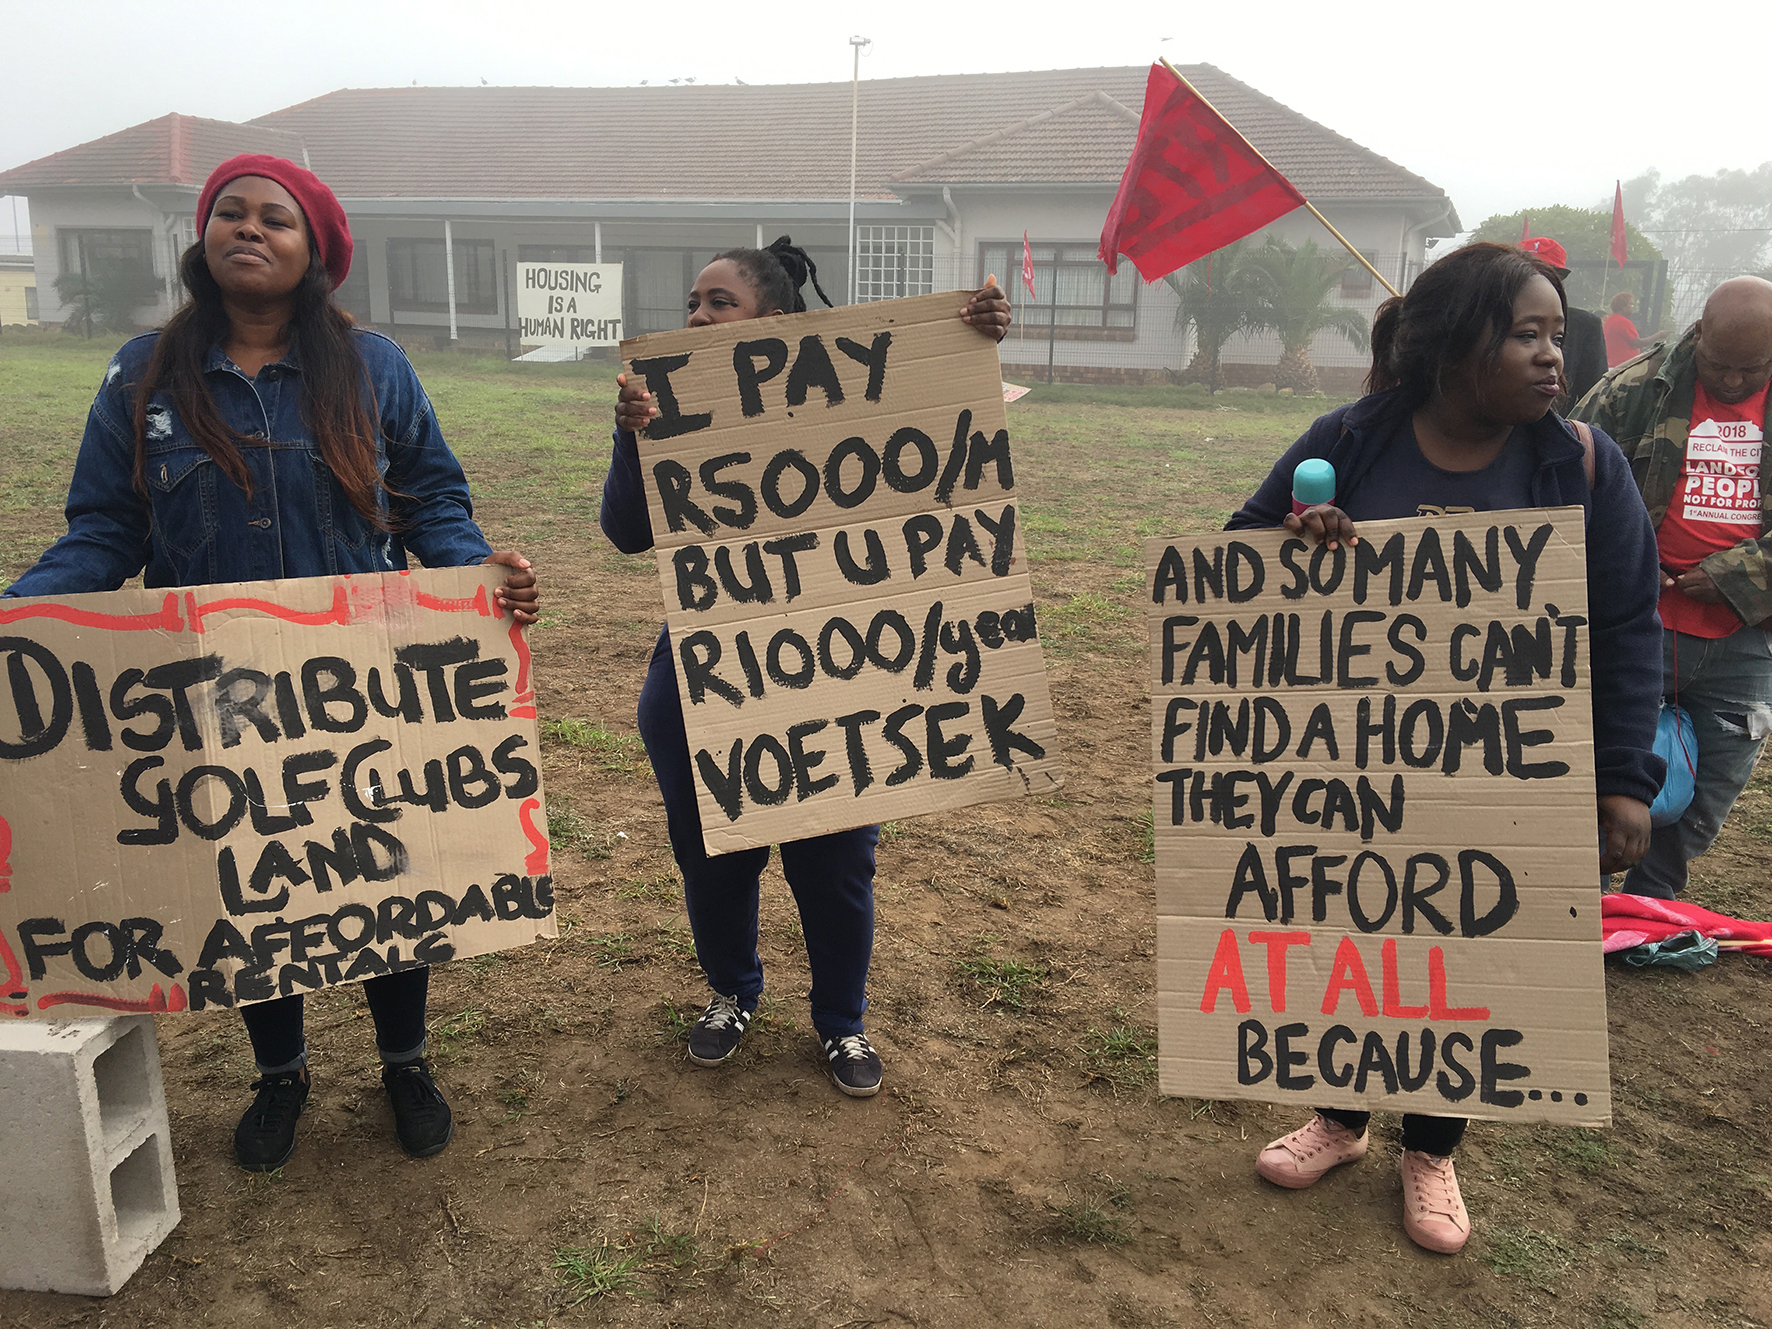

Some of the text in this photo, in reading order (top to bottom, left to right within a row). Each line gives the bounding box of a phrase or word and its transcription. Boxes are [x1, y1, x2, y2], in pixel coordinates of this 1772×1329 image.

[526, 268, 602, 293] HOUSING
[548, 295, 577, 314] IS A
[520, 317, 621, 340] HUMAN RIGHT
[631, 331, 893, 440] I PAY
[1686, 461, 1736, 475] LAND
[1730, 448, 1747, 457] THE
[1750, 448, 1761, 457] CI
[1683, 495, 1707, 504] NOT
[1711, 497, 1732, 507] FOR
[1697, 510, 1729, 520] ANNUAL
[671, 504, 1016, 611] BUT U PAY
[1152, 540, 1265, 606] AND
[1162, 603, 1587, 692] FAMILIES CAN'T
[0, 636, 508, 760] DISTRIBUTE
[1161, 694, 1570, 780] FIND A HOME
[117, 734, 538, 845] GOLF CLUBS
[694, 692, 1046, 822] VOETSEK
[1155, 768, 1403, 840] THEY CAN
[219, 823, 408, 916] LAND
[1225, 842, 1519, 937] AFFORD
[18, 873, 554, 982] FOR AFFORDABLE
[188, 931, 456, 1010] RENTALS
[1200, 928, 1490, 1020] AT ALL
